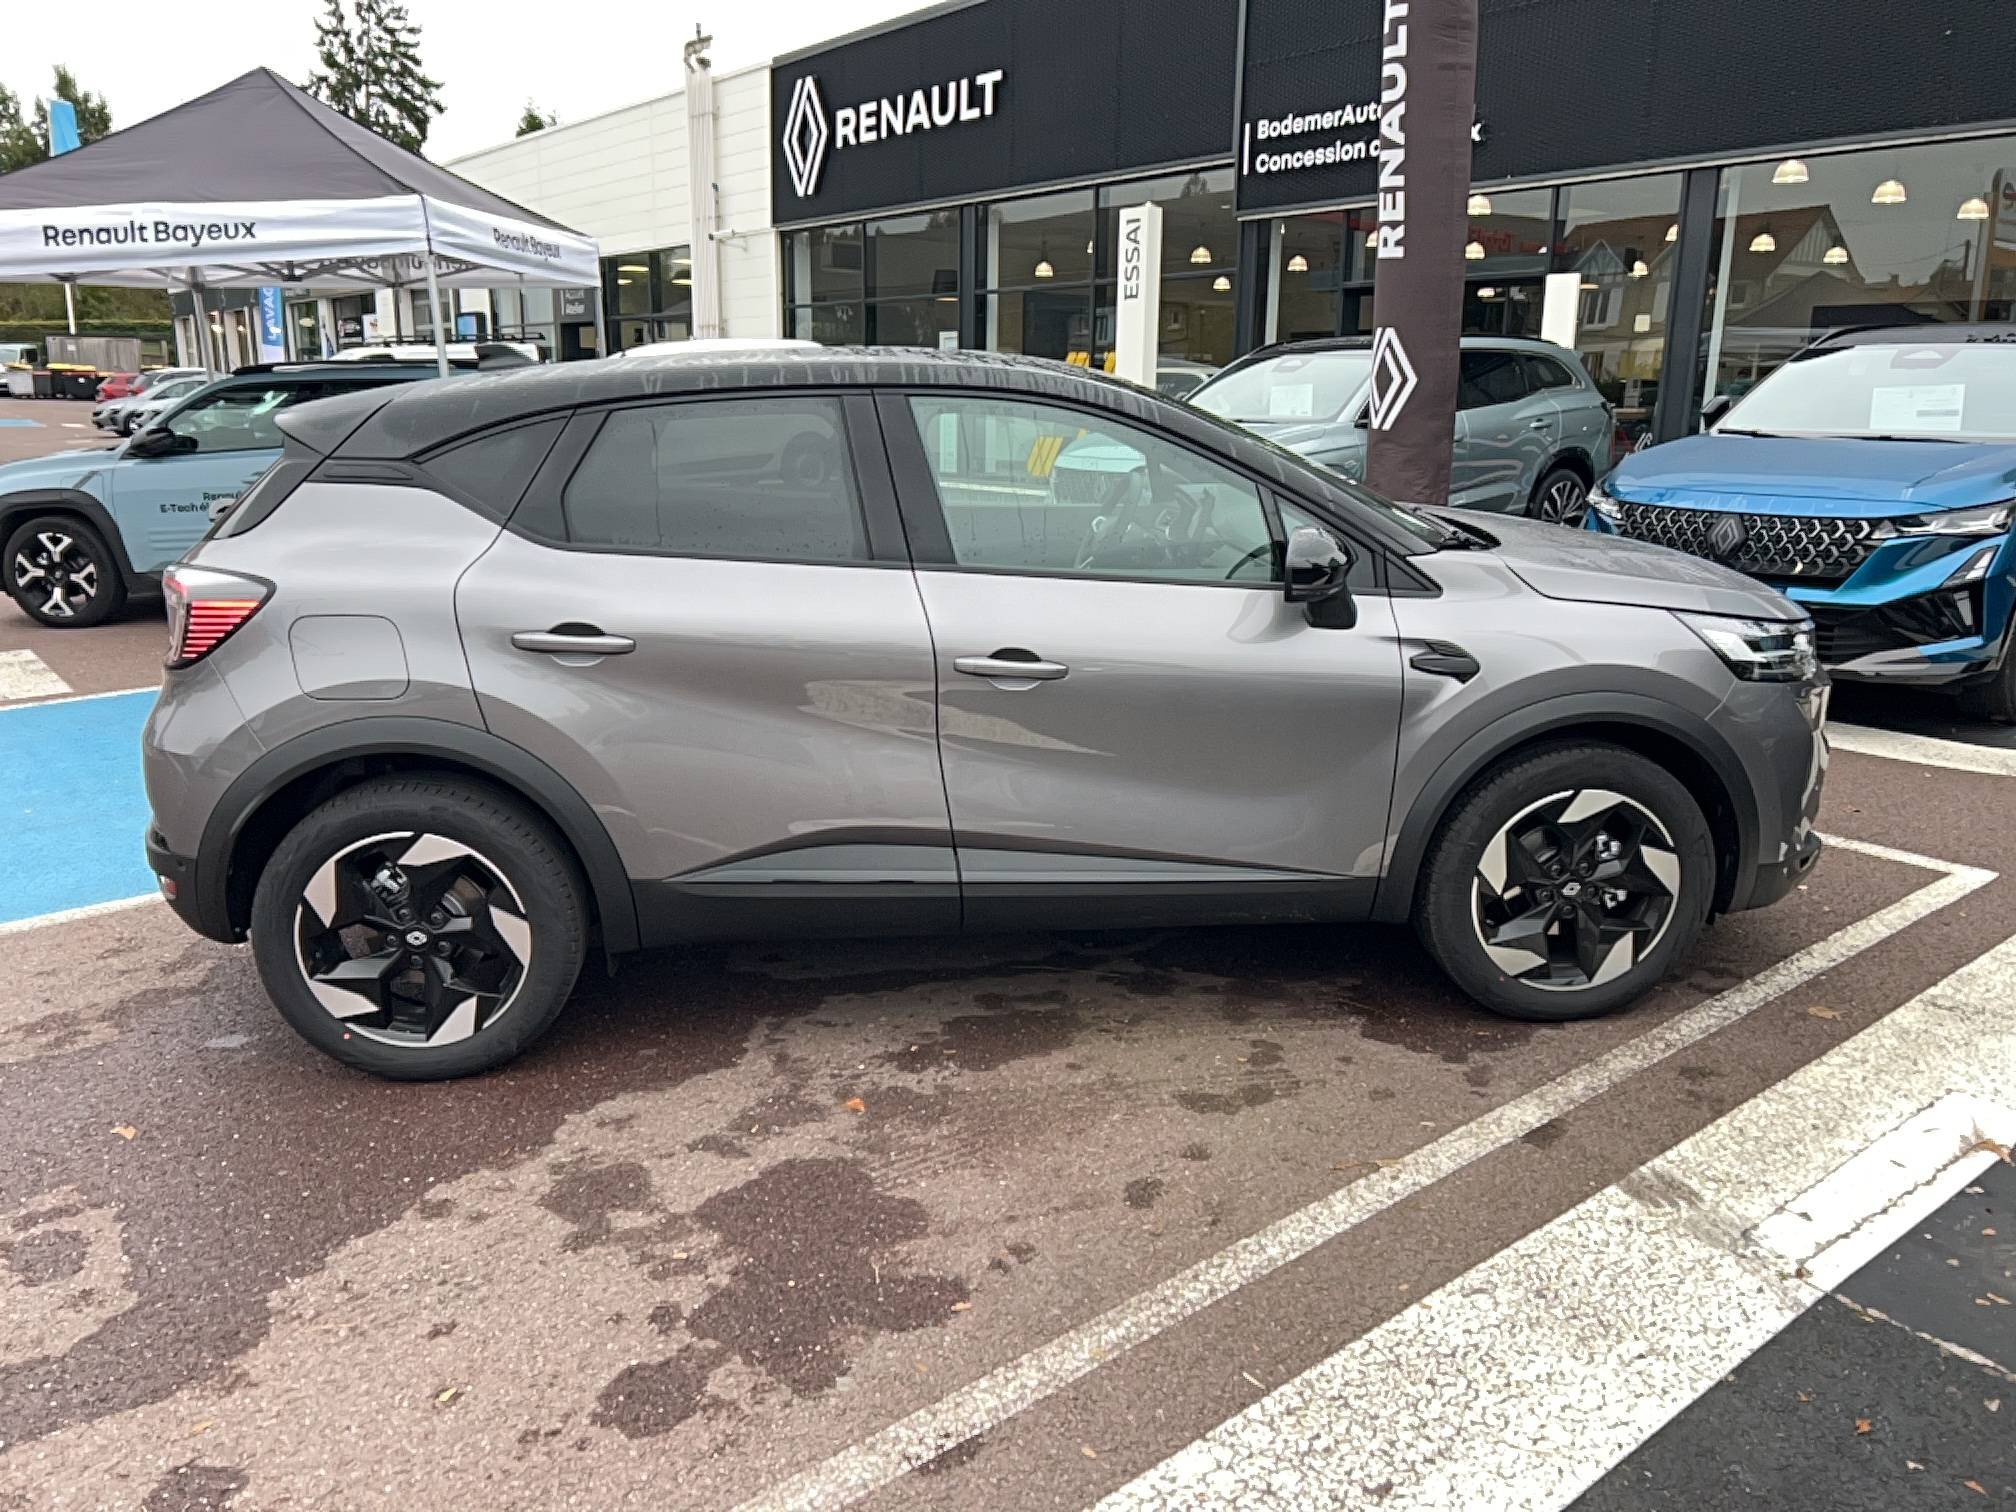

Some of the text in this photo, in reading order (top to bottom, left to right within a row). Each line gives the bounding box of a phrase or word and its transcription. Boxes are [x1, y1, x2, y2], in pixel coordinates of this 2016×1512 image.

[835, 69, 1003, 149] RENAULT
[1255, 140, 1365, 174] Concession
[42, 220, 257, 248] Renault Bayeux
[1124, 218, 1141, 300] ESSAI
